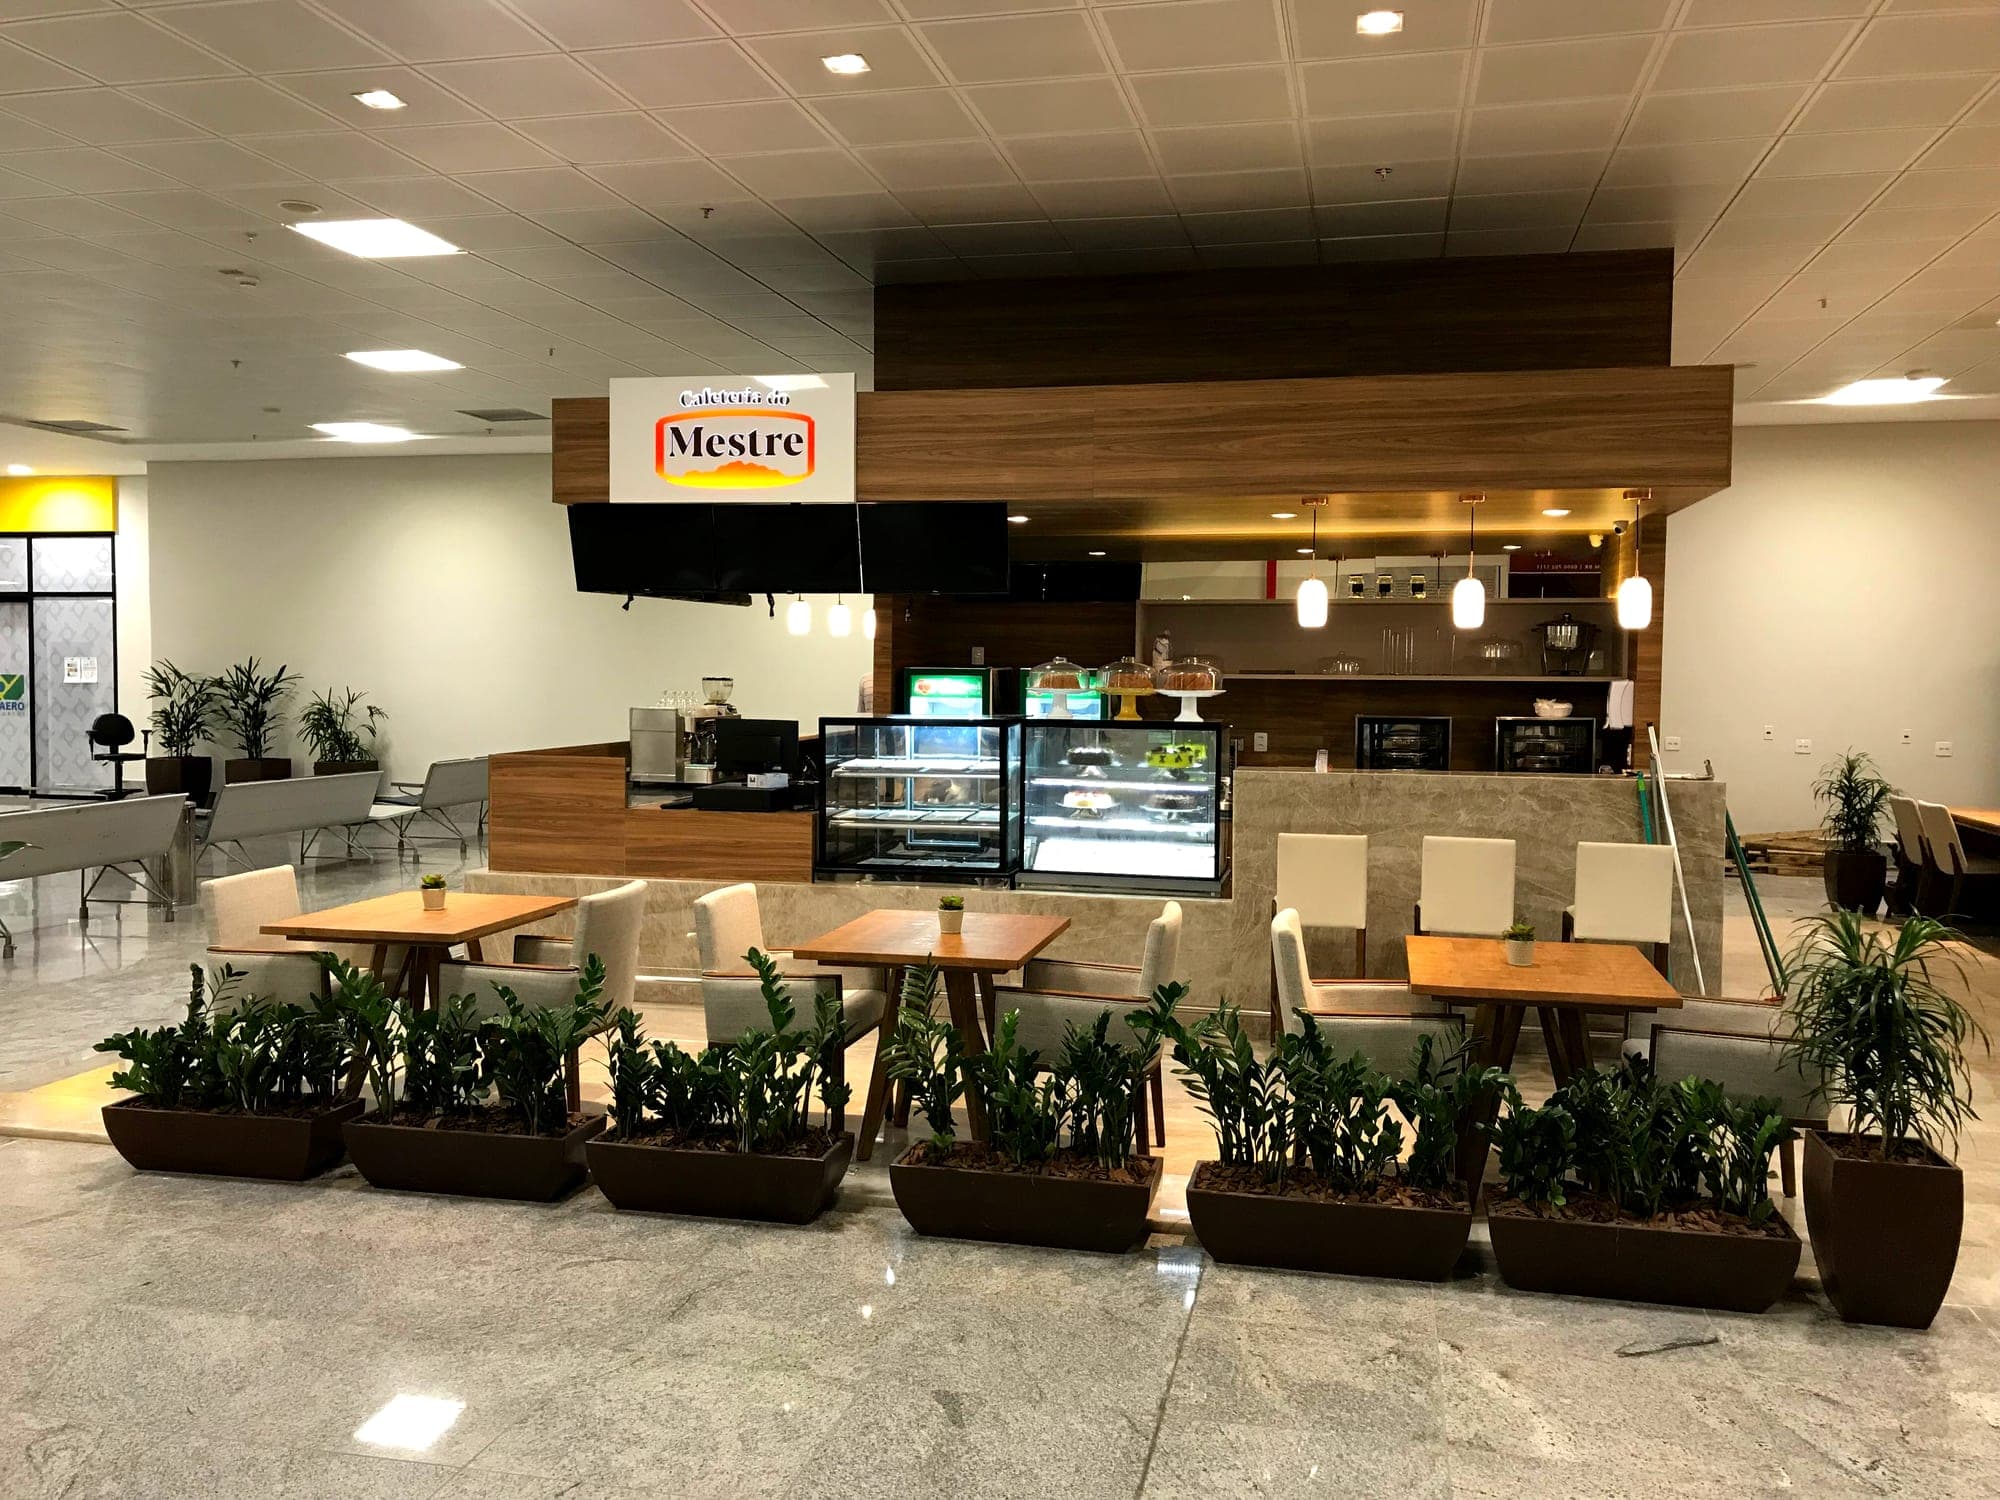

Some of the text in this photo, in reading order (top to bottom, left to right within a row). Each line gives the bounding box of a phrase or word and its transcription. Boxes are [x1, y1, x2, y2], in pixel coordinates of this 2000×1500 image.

[680, 387, 790, 406] Cafeteria do
[670, 427, 804, 457] Mestre
